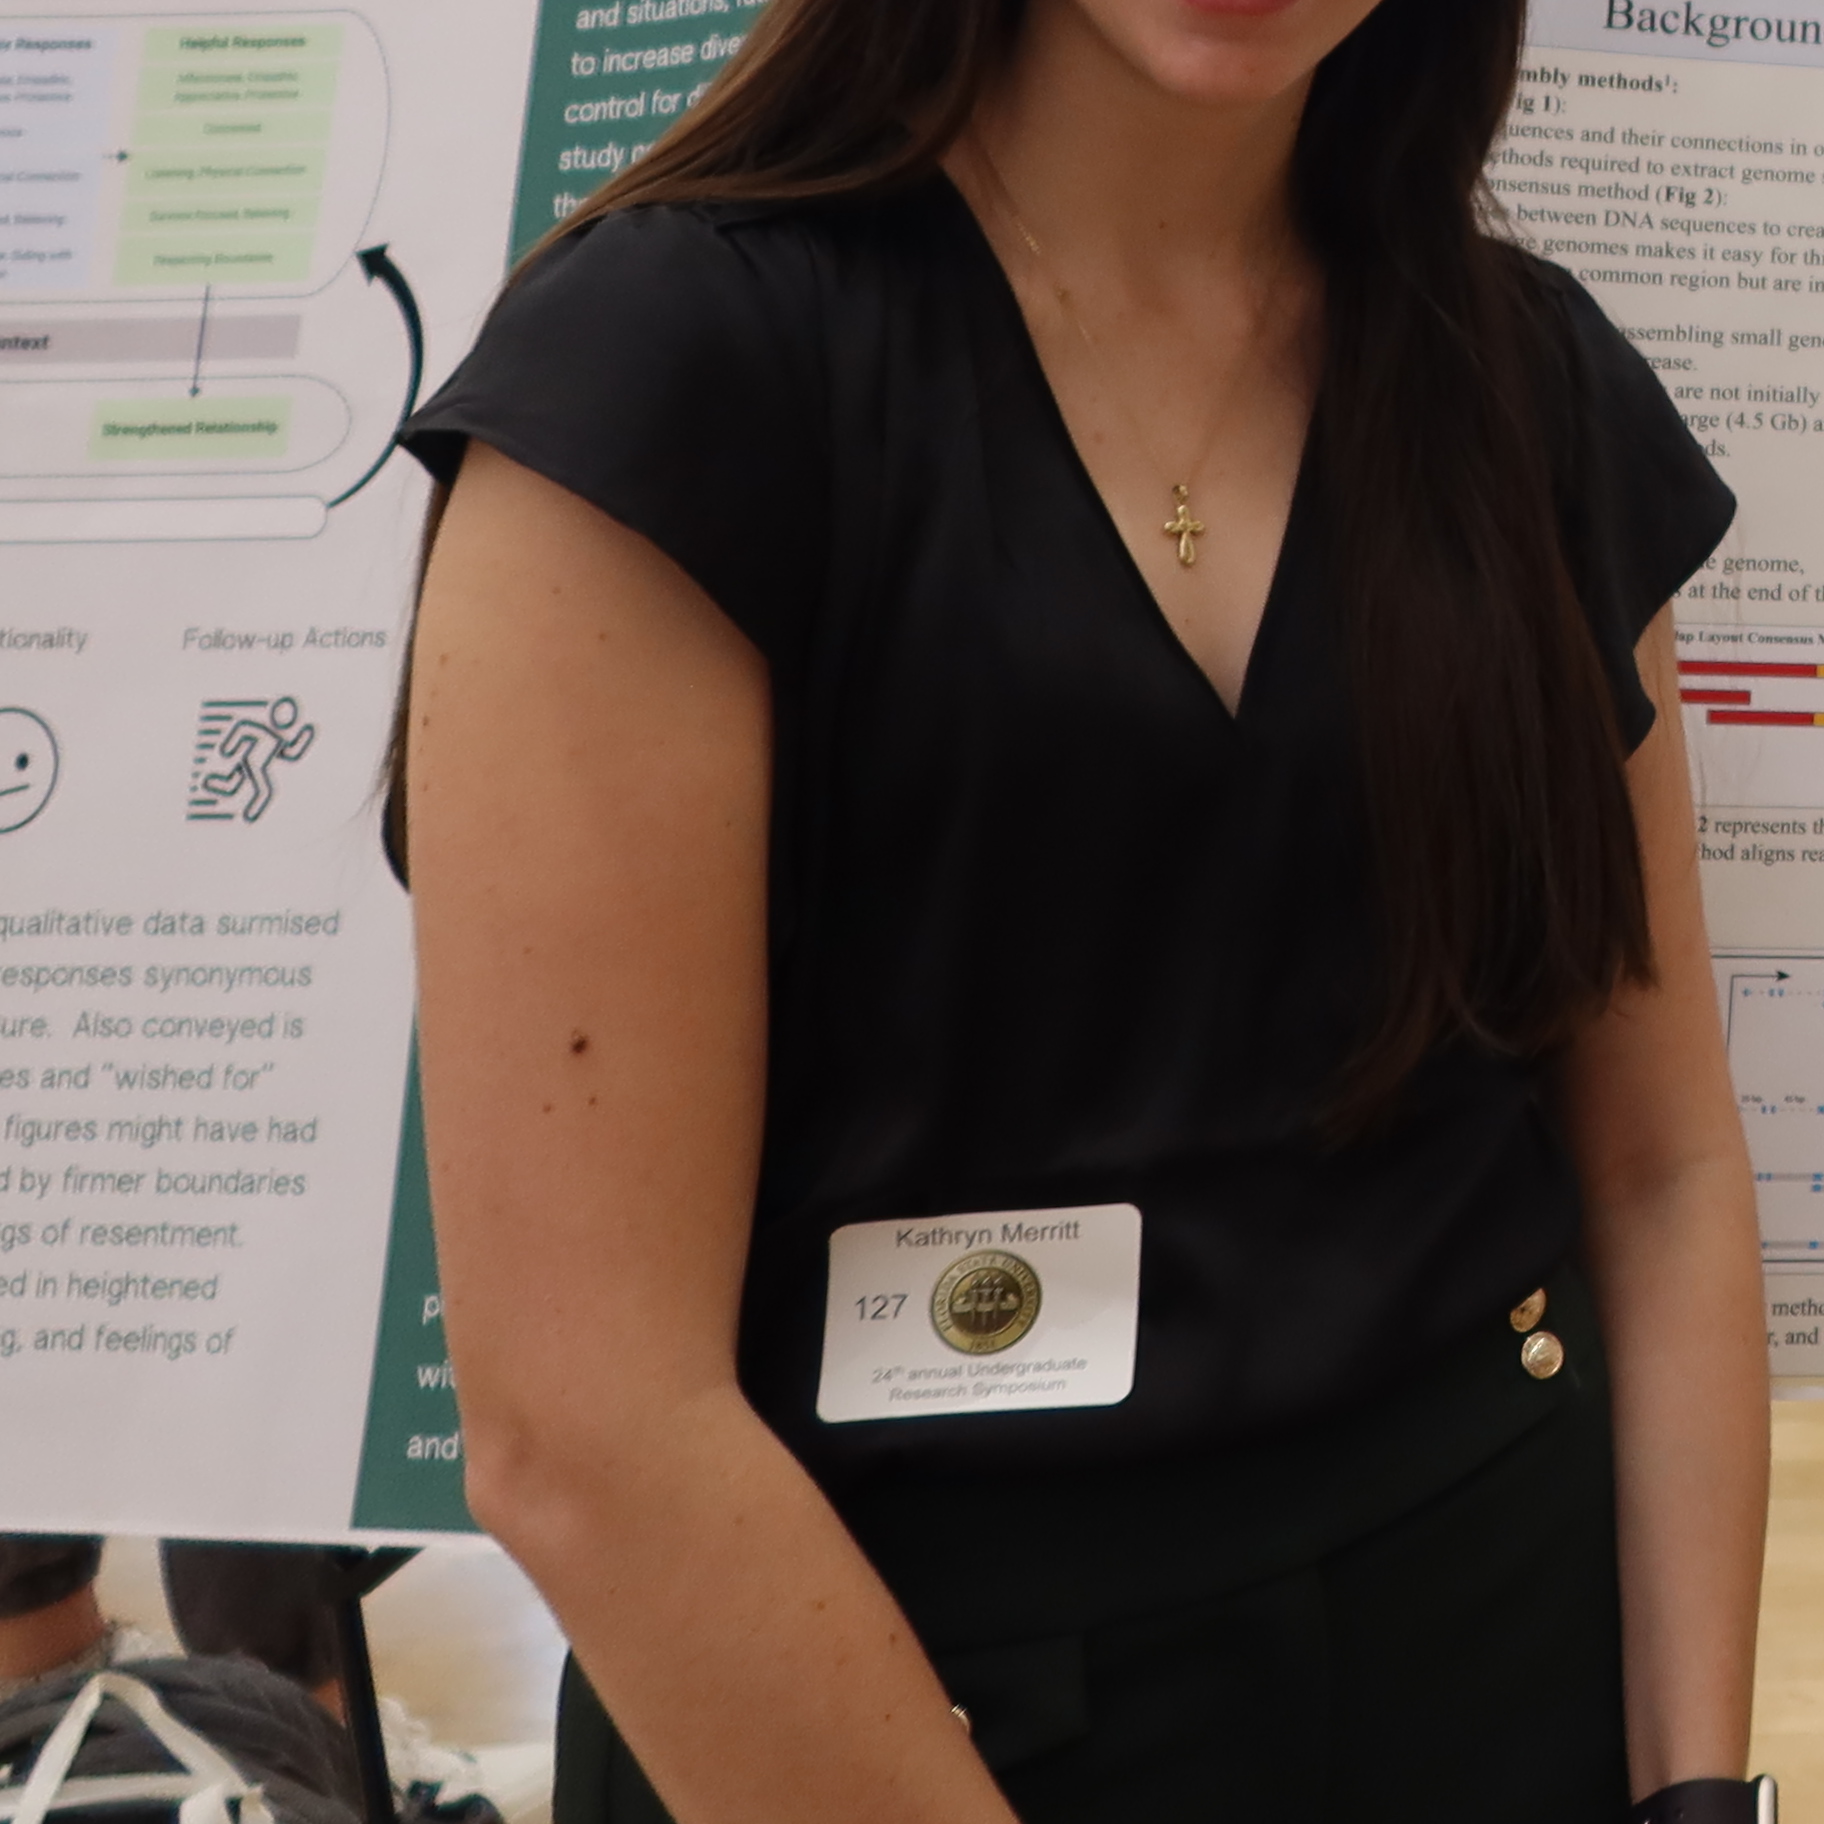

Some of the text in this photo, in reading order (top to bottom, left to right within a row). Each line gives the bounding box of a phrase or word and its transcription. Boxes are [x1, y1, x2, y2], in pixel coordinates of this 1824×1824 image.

[182, 626, 387, 655] Follow-up Actions
[896, 1220, 1081, 1249] Kathryn Merritt
[854, 1294, 909, 1321] 127
[968, 1358, 1088, 1379] Undergraduate
[888, 1379, 1067, 1402] Research Symposium
